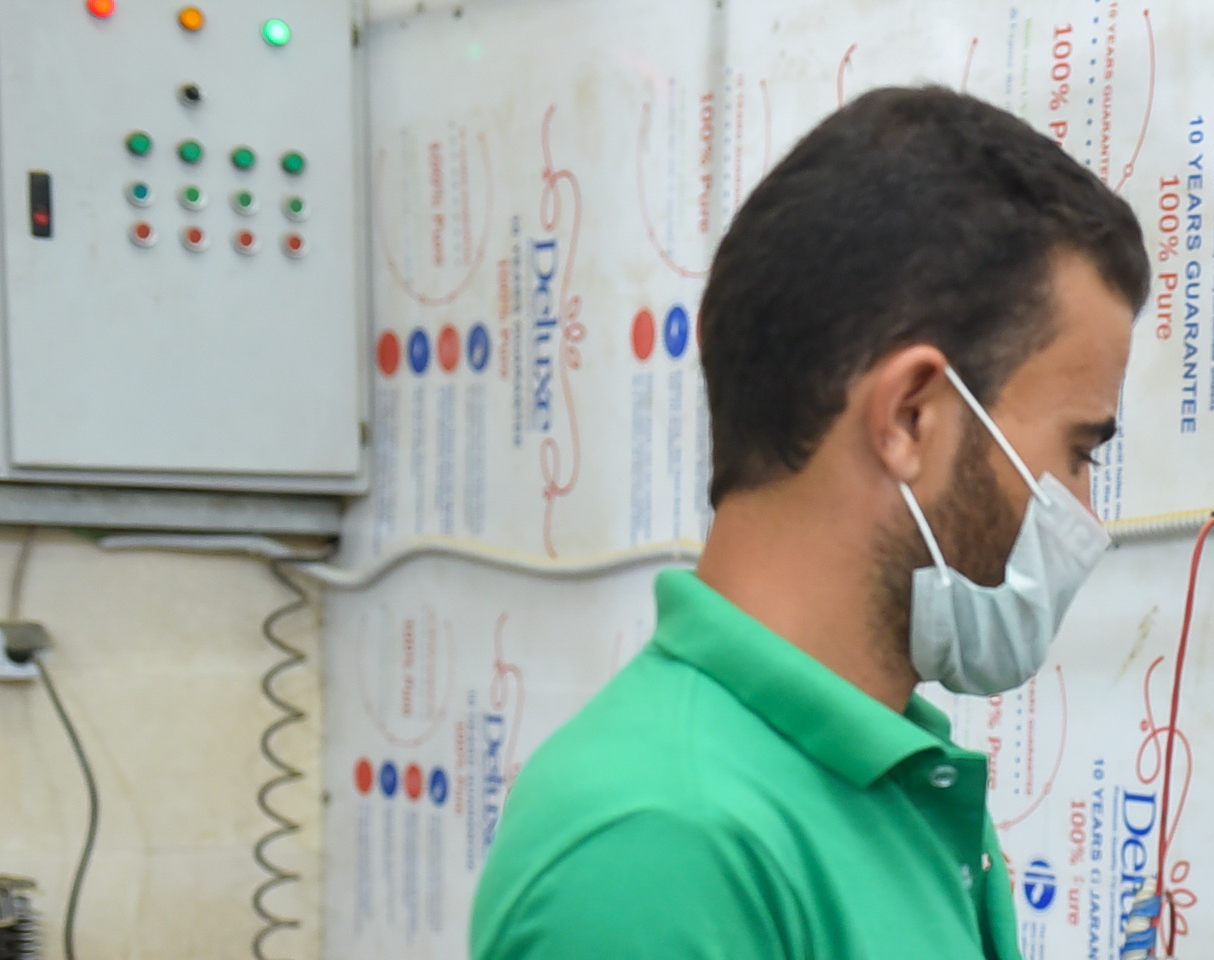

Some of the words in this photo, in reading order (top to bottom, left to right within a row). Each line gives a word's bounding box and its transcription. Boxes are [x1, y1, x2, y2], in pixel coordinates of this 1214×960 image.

[1050, 24, 1072, 110] 100%
[1189, 116, 1204, 144] 10
[1160, 176, 1180, 262] 100%
[1187, 154, 1202, 250] YEARS
[531, 237, 559, 432] Deluxe
[1156, 273, 1178, 340] Pure
[1182, 261, 1201, 432] GUARANTEE
[1093, 760, 1104, 780] 10
[1068, 798, 1086, 865] 100%
[1090, 788, 1104, 861] YEARS
